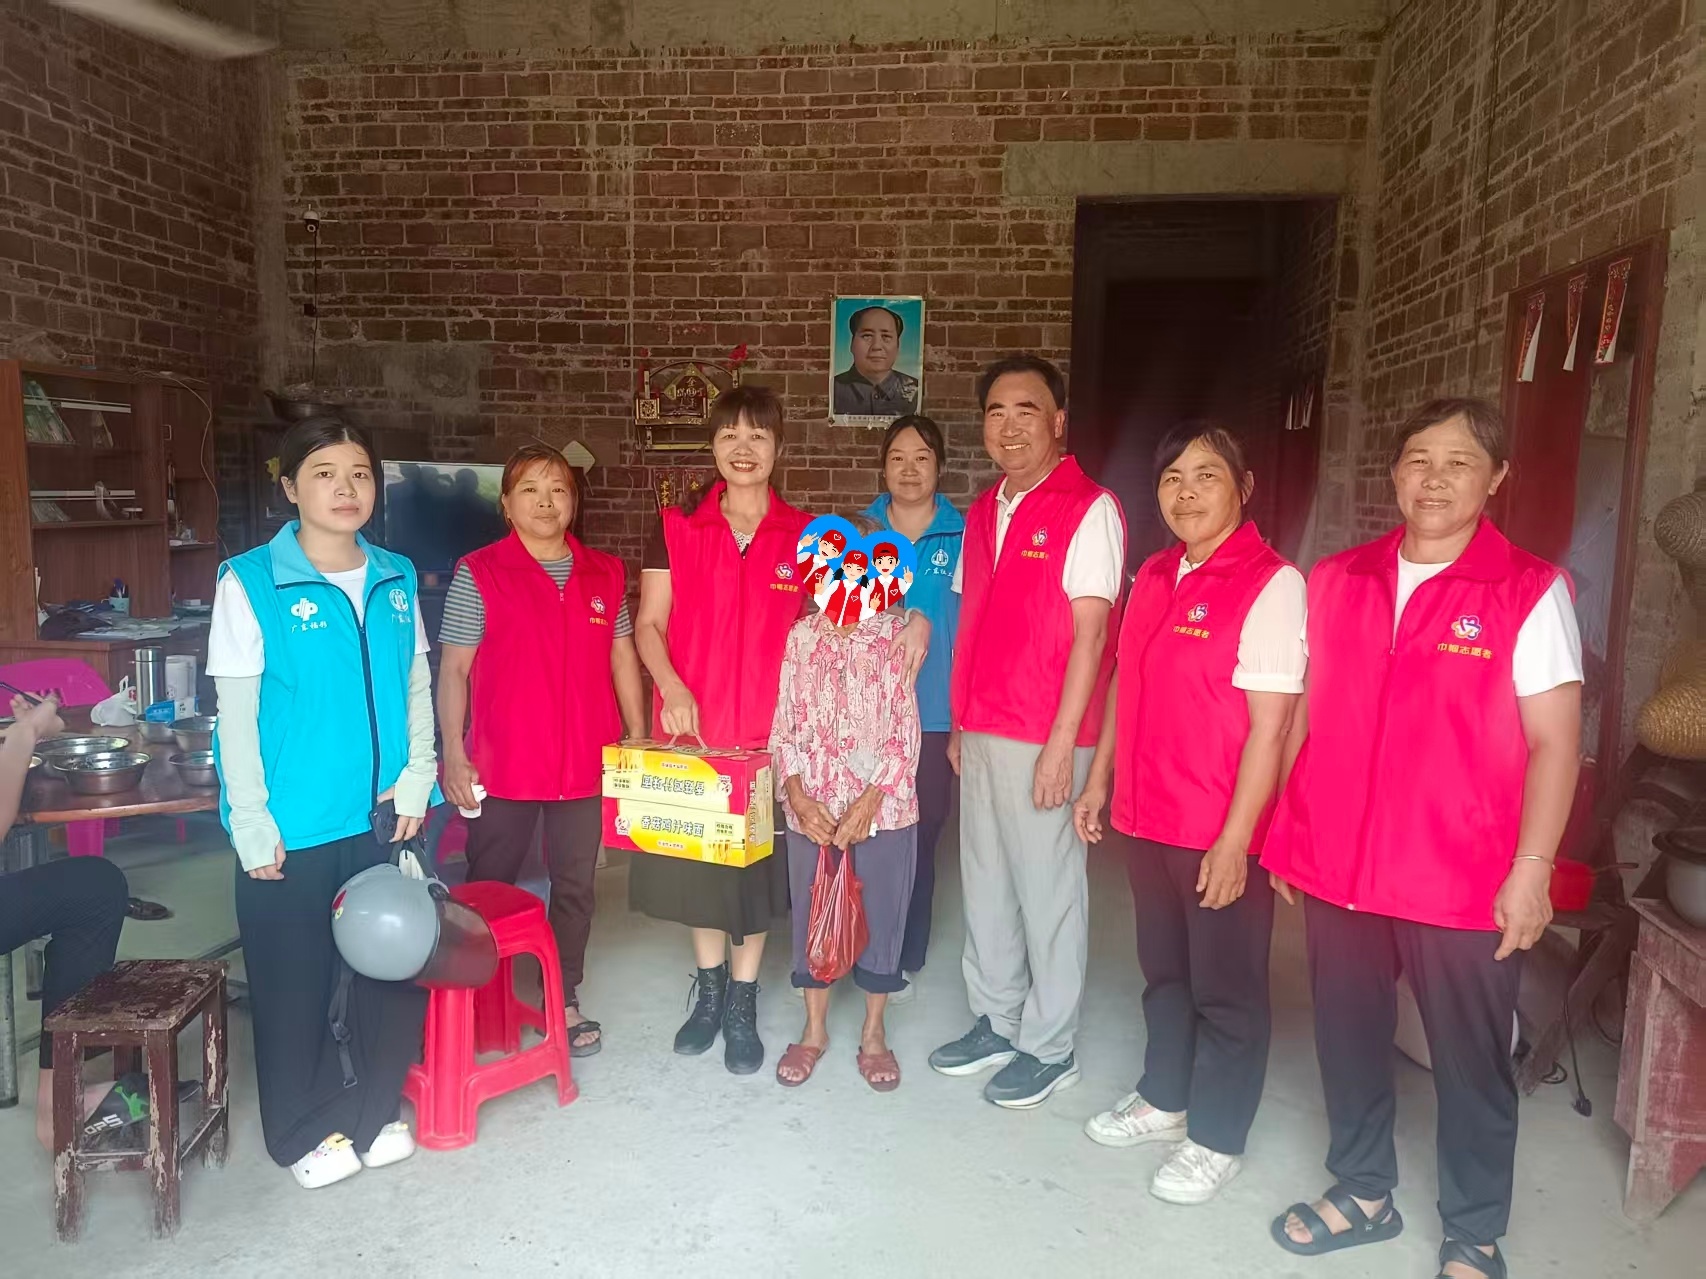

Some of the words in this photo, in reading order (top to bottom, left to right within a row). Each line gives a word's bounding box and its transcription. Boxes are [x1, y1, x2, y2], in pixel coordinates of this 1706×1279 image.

[1437, 642, 1493, 660] 巾帼志愿者
[641, 815, 705, 838] 香菇鸡汁味面
